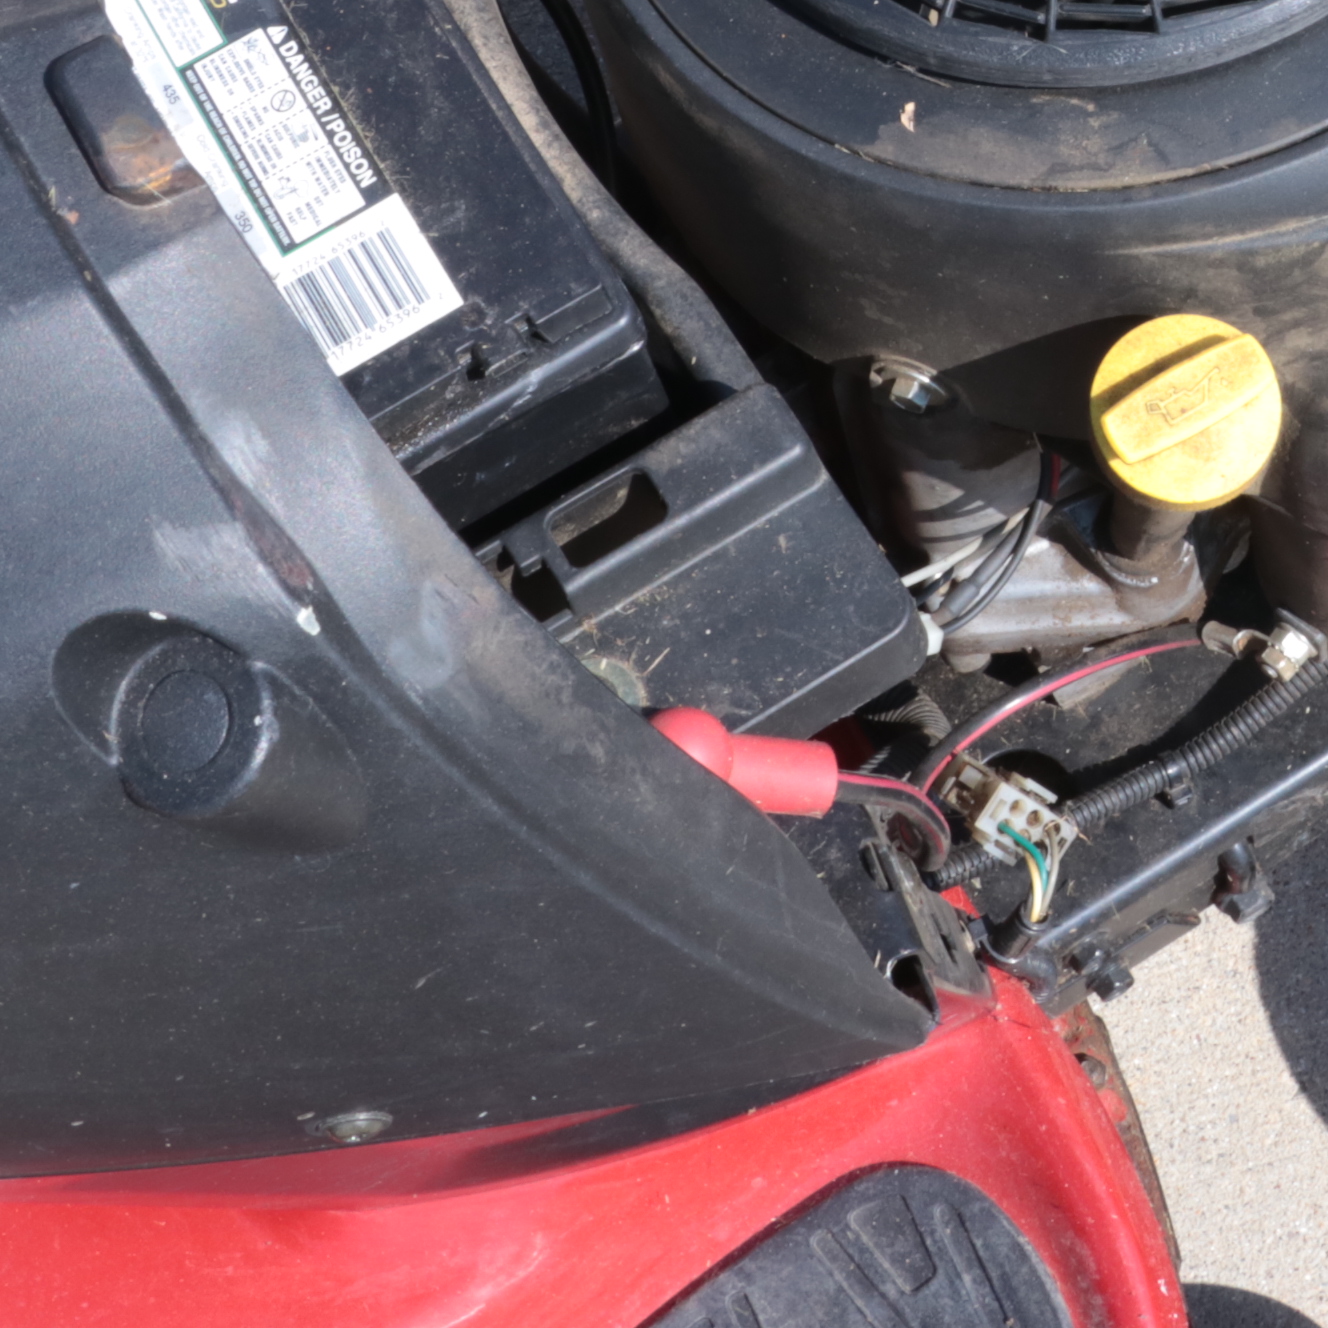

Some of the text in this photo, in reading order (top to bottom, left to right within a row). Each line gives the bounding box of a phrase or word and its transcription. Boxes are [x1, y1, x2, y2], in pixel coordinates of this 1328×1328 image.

[162, 83, 180, 105] 435
[234, 210, 254, 233] 350
[330, 332, 373, 361] 17724
[378, 304, 421, 334] 65396
